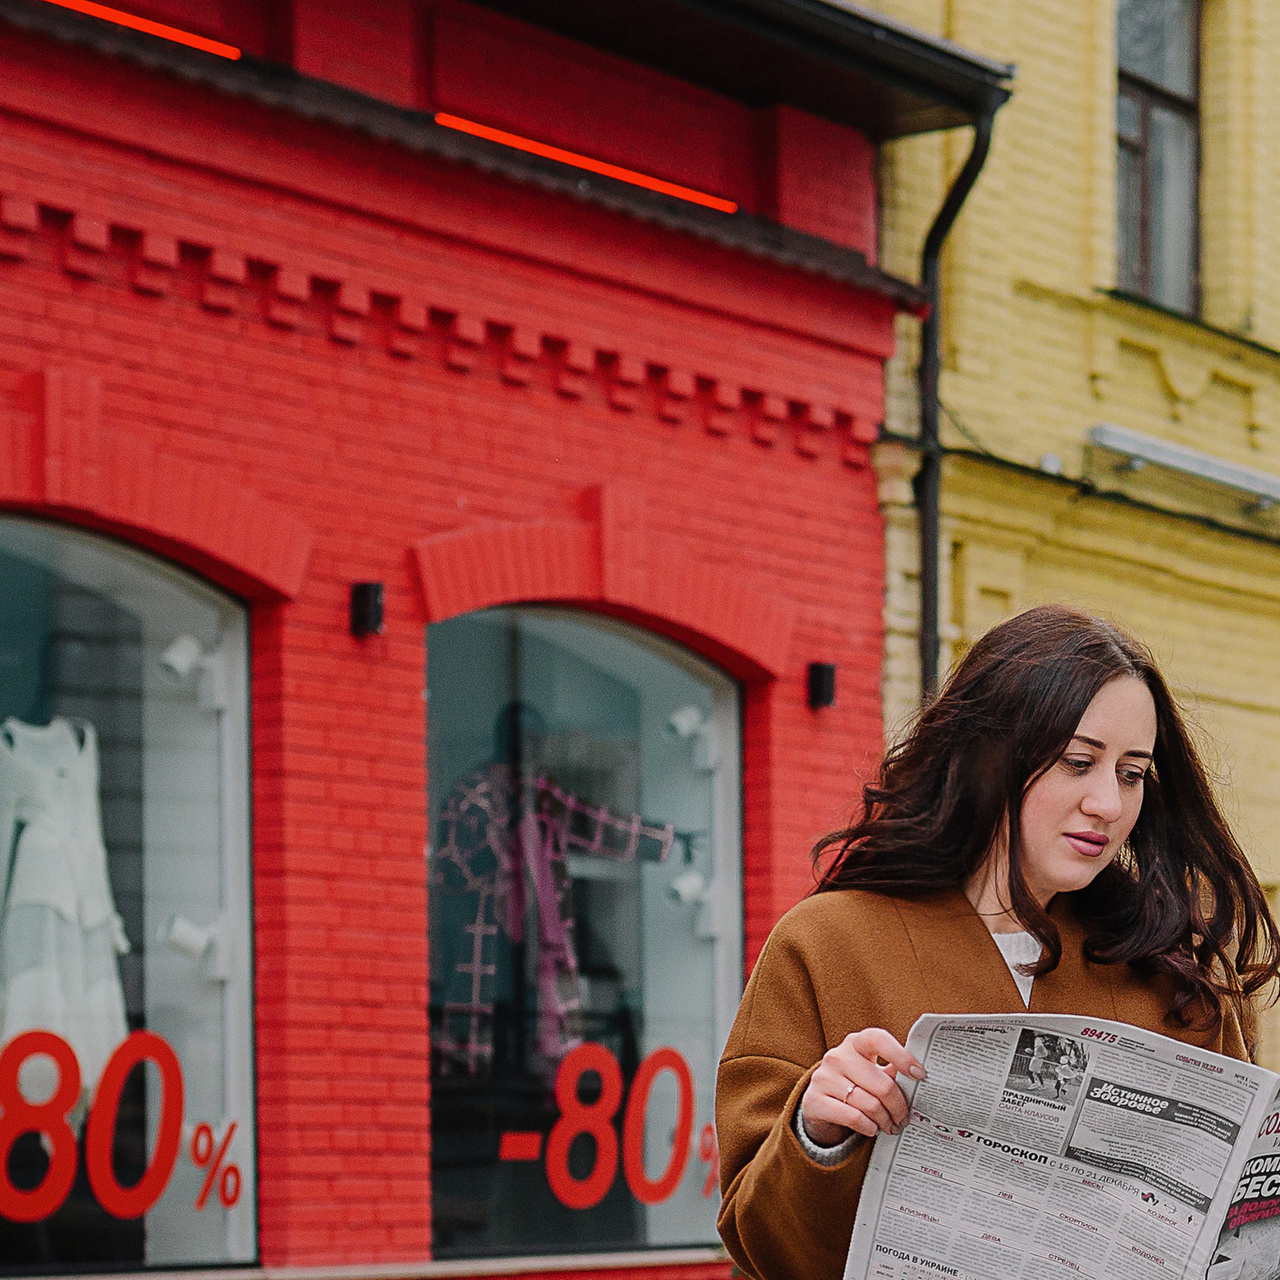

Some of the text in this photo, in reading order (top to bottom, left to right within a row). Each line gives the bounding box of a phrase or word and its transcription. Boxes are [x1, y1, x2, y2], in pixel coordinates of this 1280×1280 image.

[1080, 1027, 1119, 1043] 89475
[1000, 1097, 1027, 1108] ЗАБЕГ
[1002, 1090, 1067, 1112] ПРАЗДНИЧНЫЙ
[1089, 1086, 1162, 1115] Здоровье
[1102, 1082, 1170, 1110] Истинное
[998, 1103, 1060, 1123] САНТА КЛАУСОВ
[920, 1166, 945, 1179] ТЕЛЕЦ
[976, 1135, 1140, 1196] ГОРОСКОП С 15 ПО 21 ДЕКАБРЯ
[1082, 1179, 1104, 1190] ВЕСЫ
[998, 1191, 1013, 1200] ЛЕВ
[900, 1206, 940, 1224] БЛИЗНЕЦЫ
[1059, 1213, 1099, 1232] СКОРПИОН
[1147, 1208, 1178, 1227] КОЗЕРОГ
[981, 1233, 1001, 1243] ДЕВА
[876, 1244, 910, 1262] ПОГОДА
[912, 1255, 918, 1263] В
[920, 1258, 959, 1277] УКРАИНЕ
[1049, 1253, 1080, 1271] СТРЕЛЕЦ
[1131, 1246, 1165, 1266] ВОДОЛЕЙ
